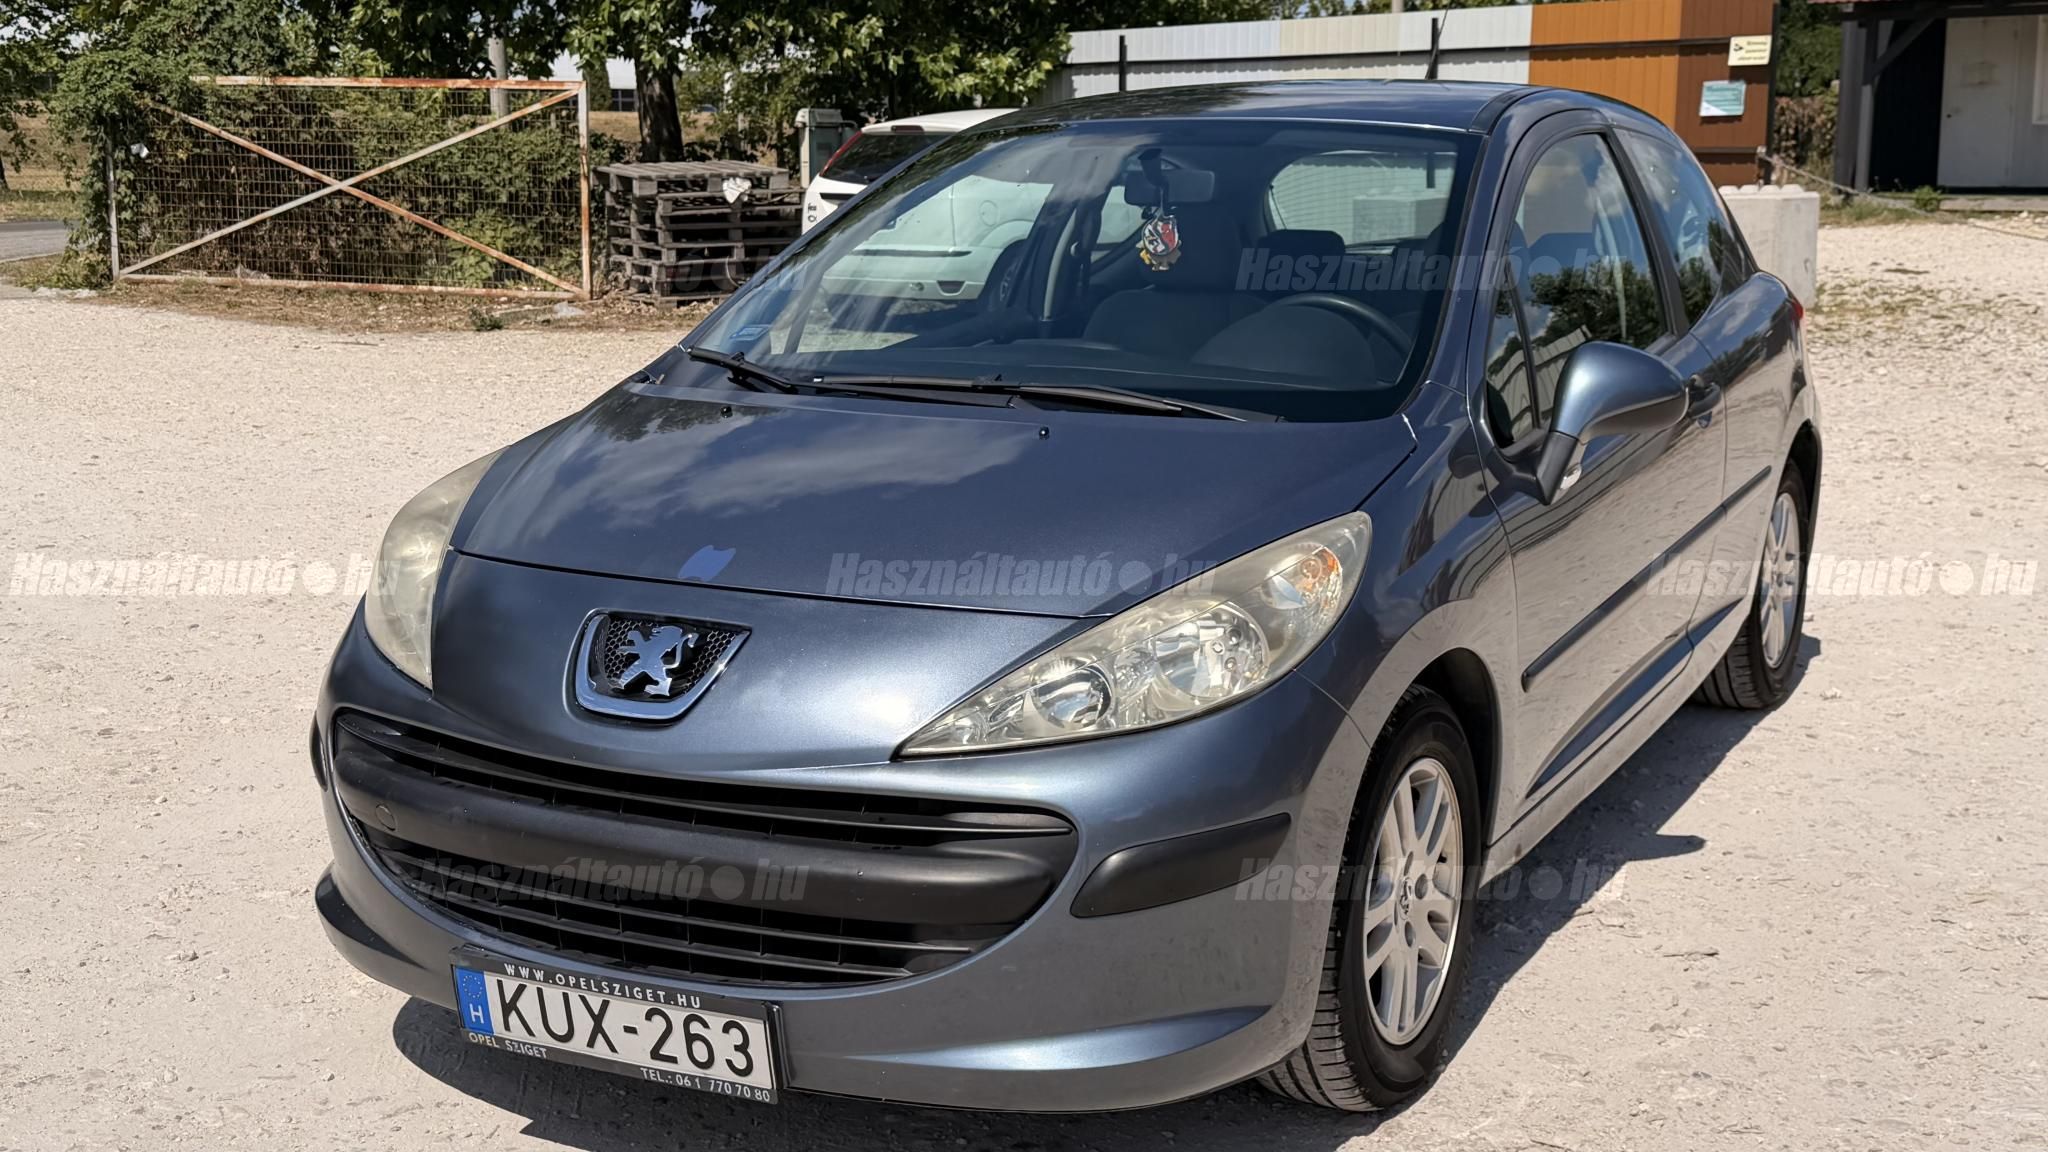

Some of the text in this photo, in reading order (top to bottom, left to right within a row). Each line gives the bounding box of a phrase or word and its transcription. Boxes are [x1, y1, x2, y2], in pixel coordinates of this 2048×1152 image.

[504, 963, 701, 1009] WWW.OPELSZIGET.HU
[469, 1003, 485, 1024] H
[497, 979, 754, 1078] KUX-263
[468, 1032, 548, 1059] OPEL SZIGET
[709, 1080, 732, 1095] 770
[735, 1084, 751, 1099] 70
[754, 1089, 771, 1102] 80
